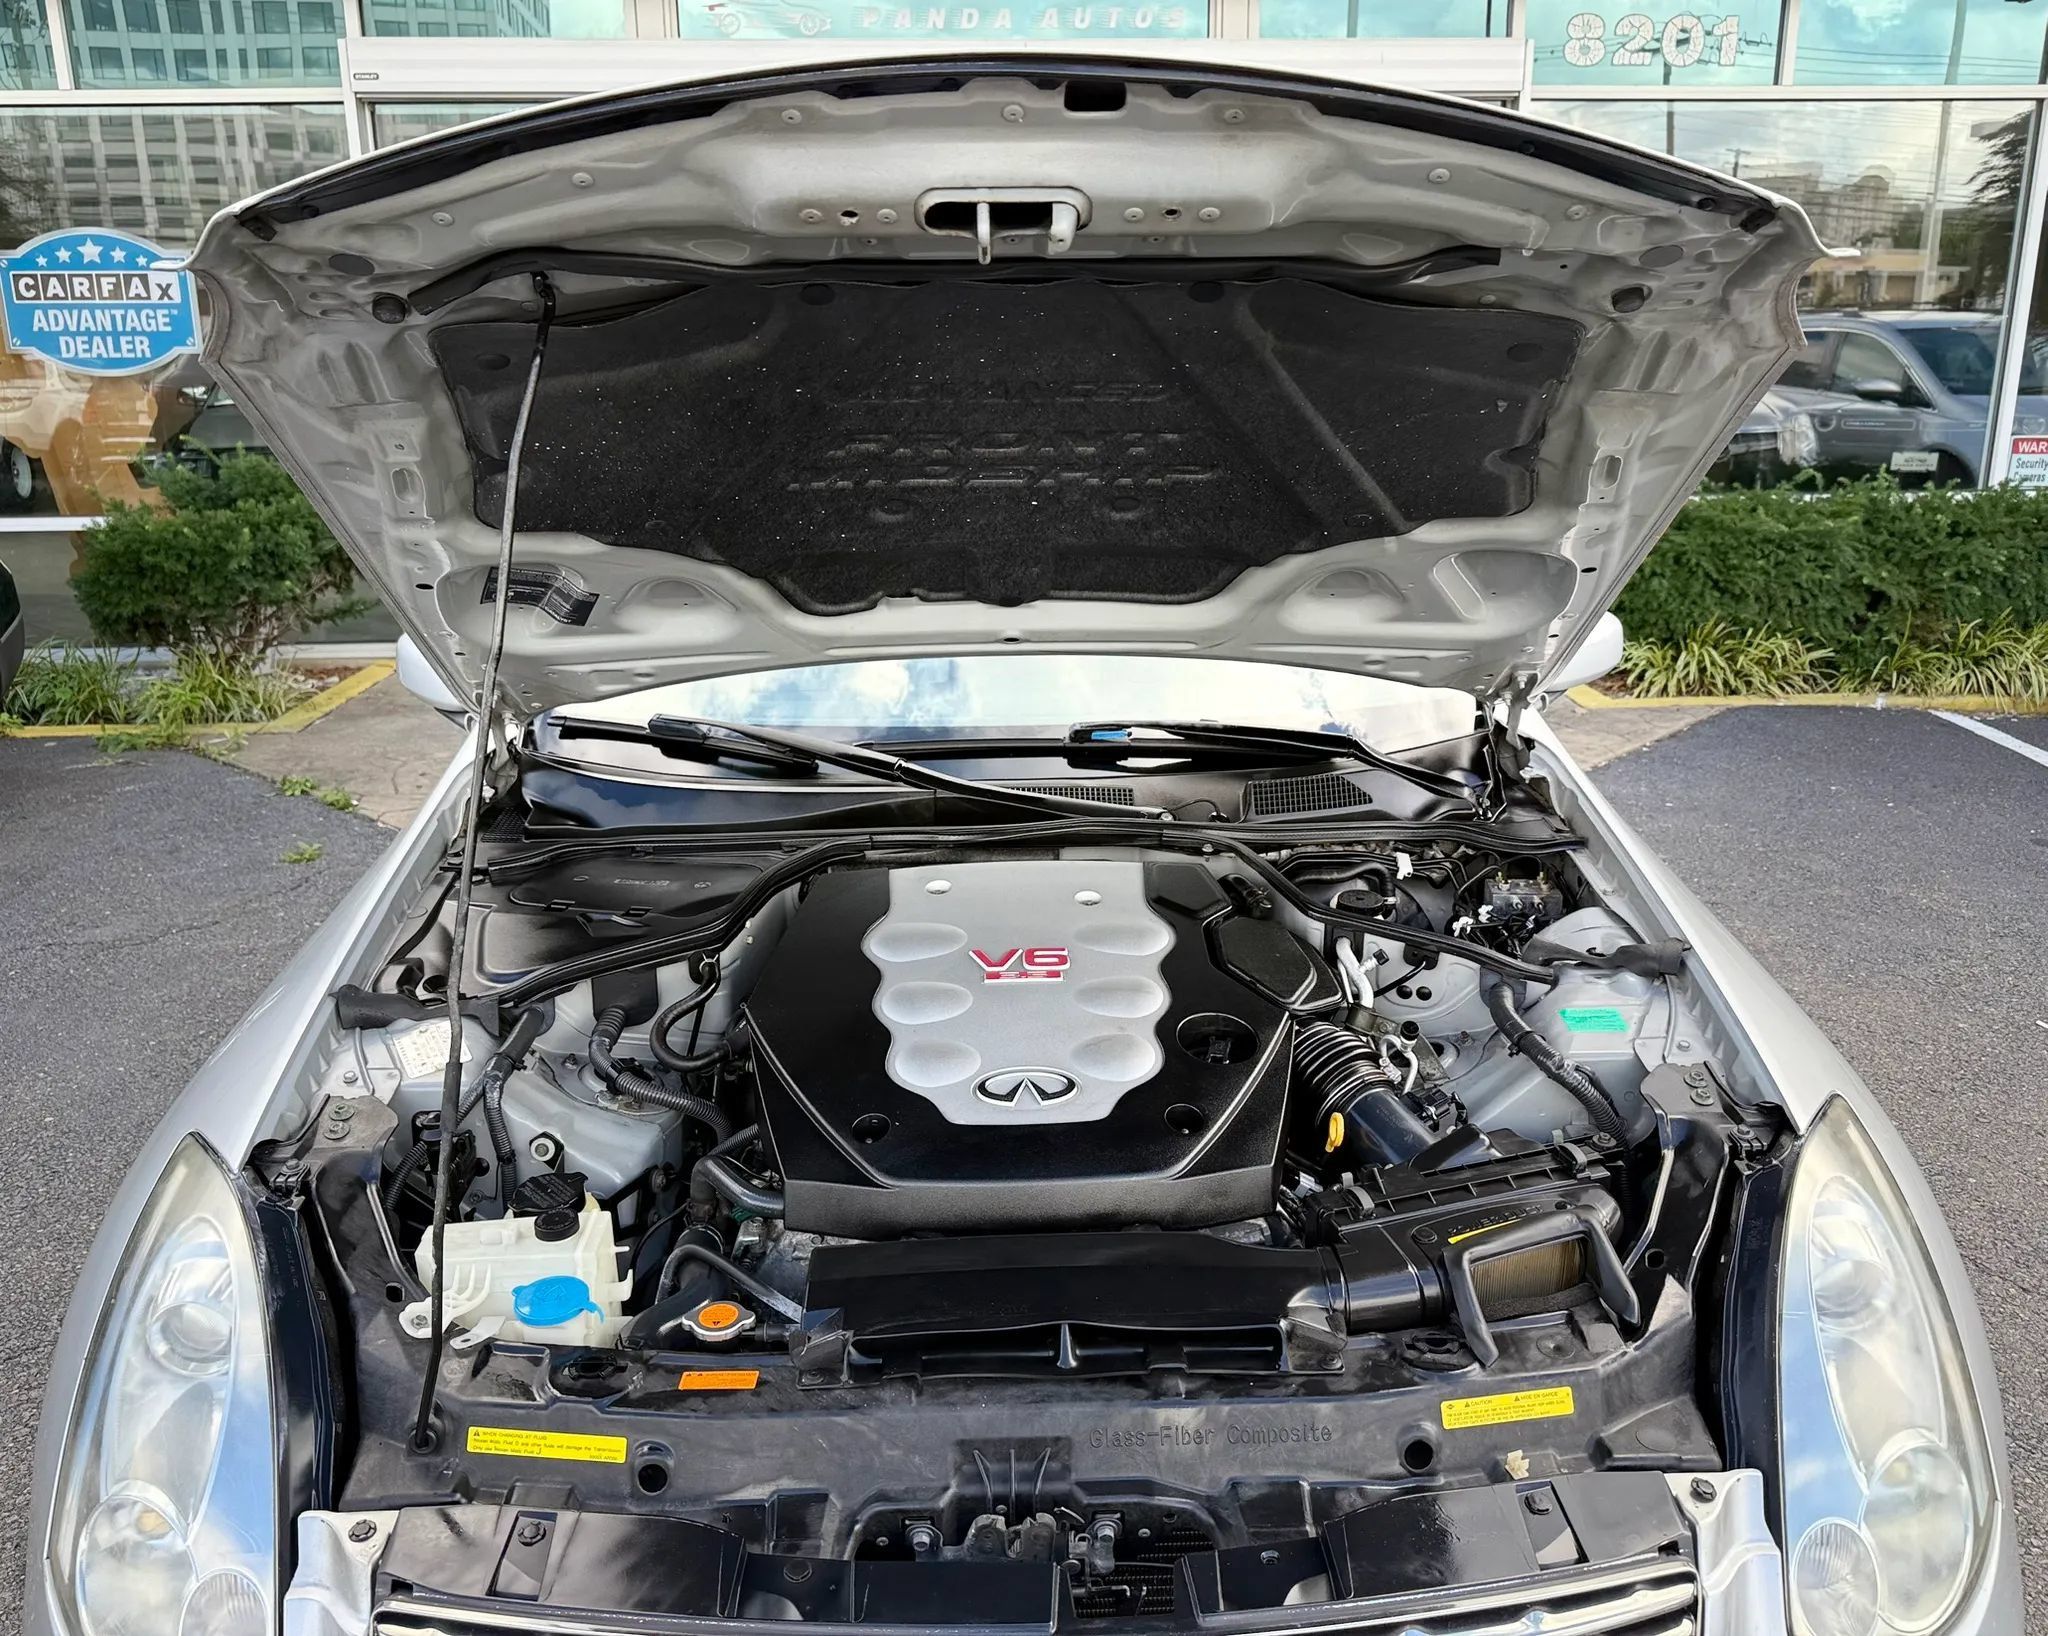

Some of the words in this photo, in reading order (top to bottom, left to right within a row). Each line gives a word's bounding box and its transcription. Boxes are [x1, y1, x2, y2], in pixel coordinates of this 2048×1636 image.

[860, 7, 1013, 29] PANDA
[1041, 7, 1186, 29] AUTOS
[1563, 13, 1740, 67] 8201
[17, 275, 176, 301] CARFAX
[58, 335, 152, 359] DEALER
[2018, 440, 2048, 454] WAR
[2015, 456, 2048, 471] Security
[967, 946, 1071, 972] V6
[1089, 1425, 1215, 1449] Glass-Fiber
[1226, 1423, 1333, 1447] Composite
